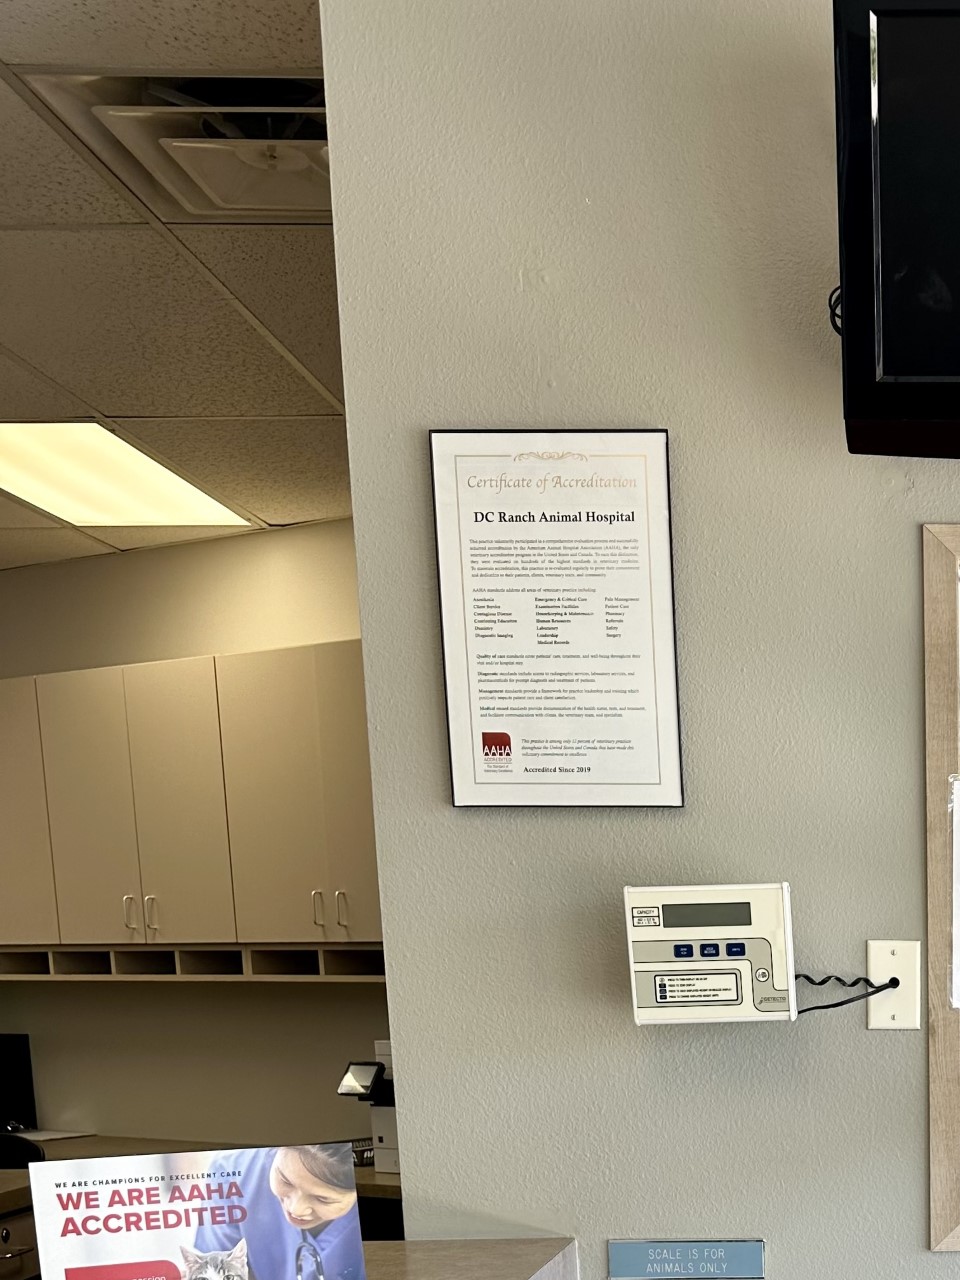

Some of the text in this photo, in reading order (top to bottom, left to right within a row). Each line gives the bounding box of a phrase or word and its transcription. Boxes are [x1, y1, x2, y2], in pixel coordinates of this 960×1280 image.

[467, 473, 637, 494] Certificate of Accreditation
[474, 511, 634, 524] DC Ranch Animal Hospital
[483, 747, 512, 756] AAHA
[92, 1178, 145, 1186] CHAMPIONS
[170, 1172, 217, 1181] EXCELLENT
[56, 1181, 244, 1211] WE ARE AAHA
[60, 1204, 247, 1238] ACCREDITED
[649, 1249, 725, 1259] SCALE IS FOR
[646, 1263, 727, 1273] ANIMALS ONLY
